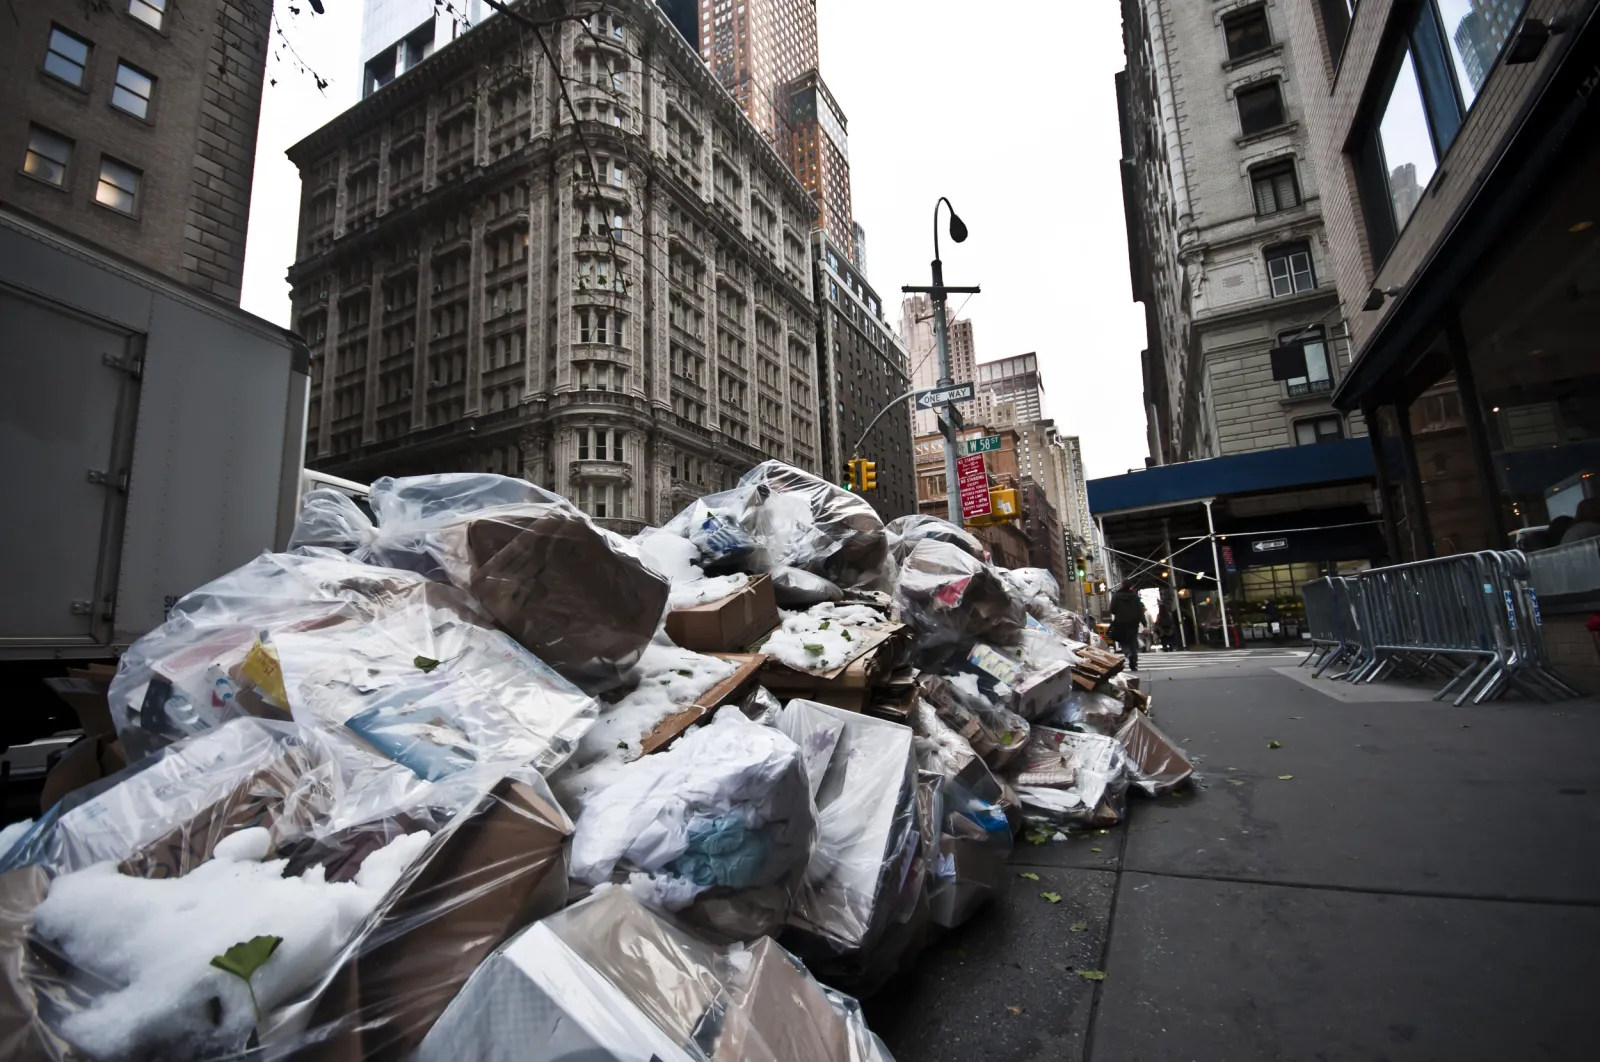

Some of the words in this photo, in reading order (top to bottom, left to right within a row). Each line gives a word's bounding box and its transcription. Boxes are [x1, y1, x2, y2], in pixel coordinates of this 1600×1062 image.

[924, 394, 941, 404] ONE
[948, 389, 967, 399] WAY
[970, 441, 977, 452] W
[980, 439, 991, 451] 58
[967, 475, 985, 483] STANDING
[1064, 531, 1075, 581] WELLINGTON
[1504, 592, 1516, 628] NYPD
